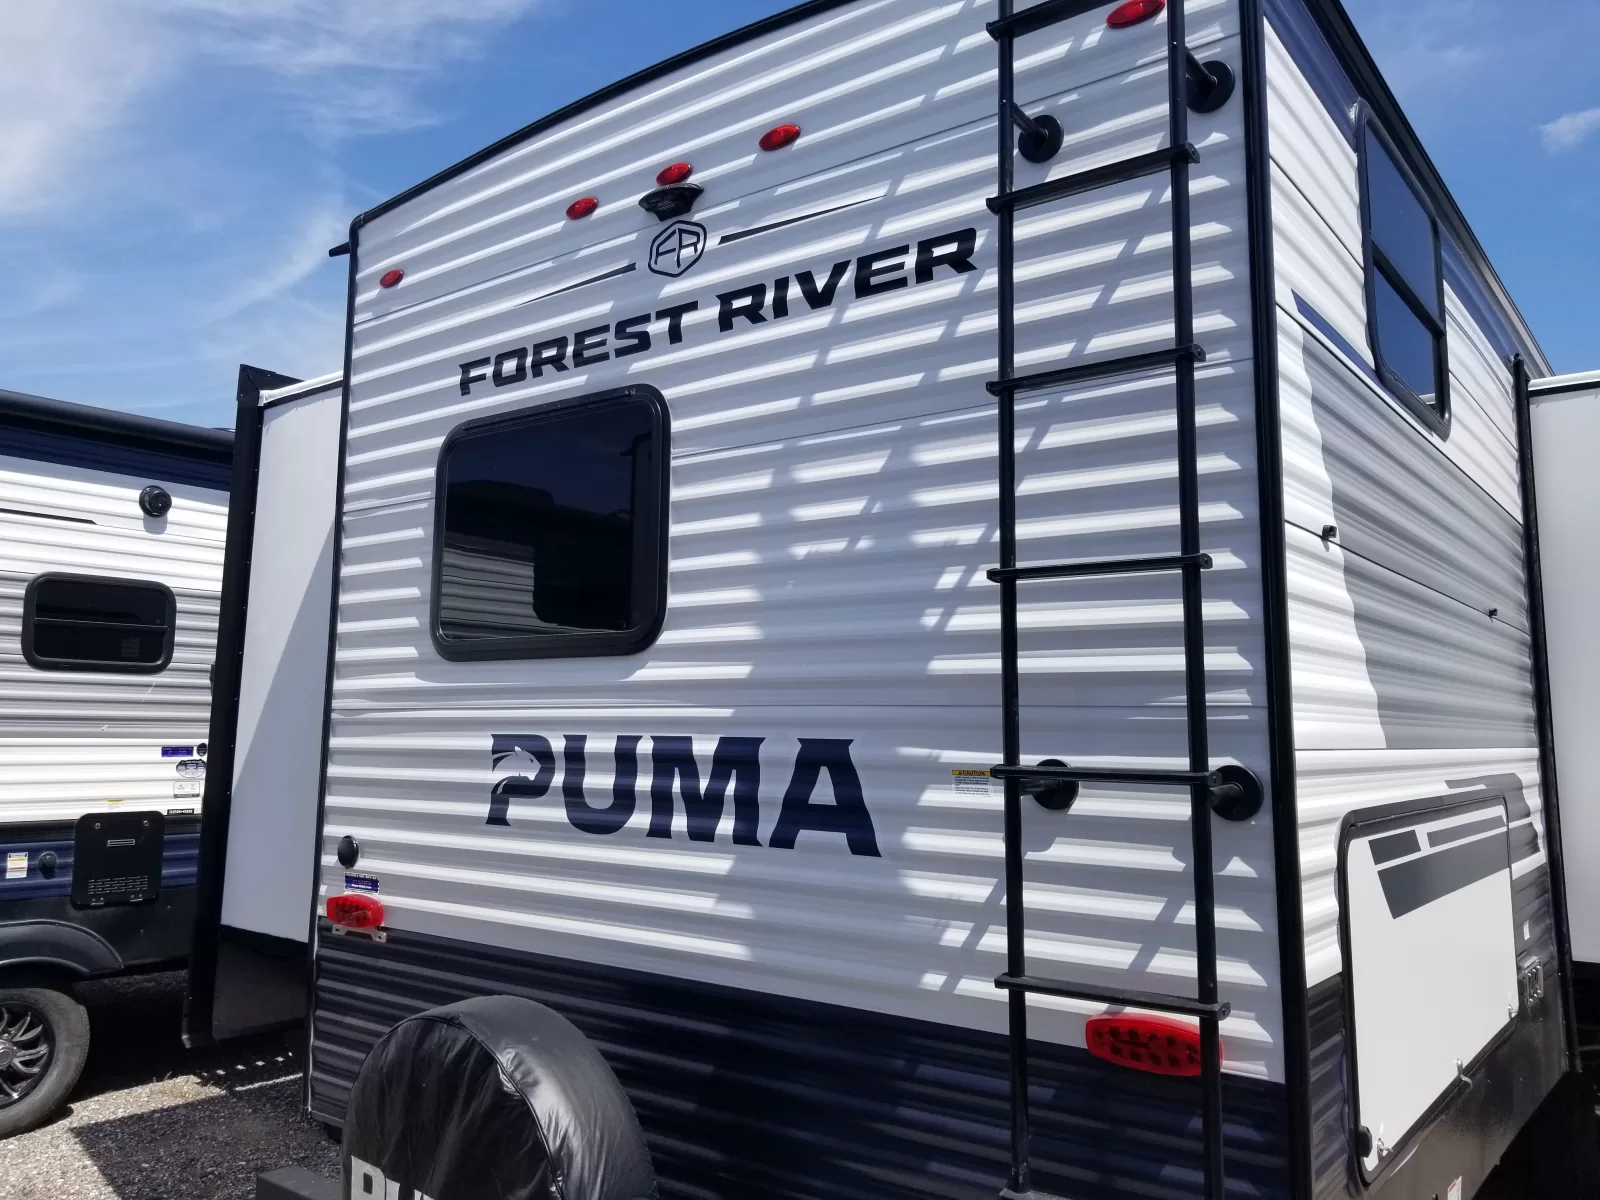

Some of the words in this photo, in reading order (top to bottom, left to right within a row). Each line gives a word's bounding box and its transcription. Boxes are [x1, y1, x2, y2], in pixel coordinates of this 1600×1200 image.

[458, 301, 699, 397] FOREST
[715, 227, 978, 333] RIVER
[485, 733, 883, 858] PUMA
